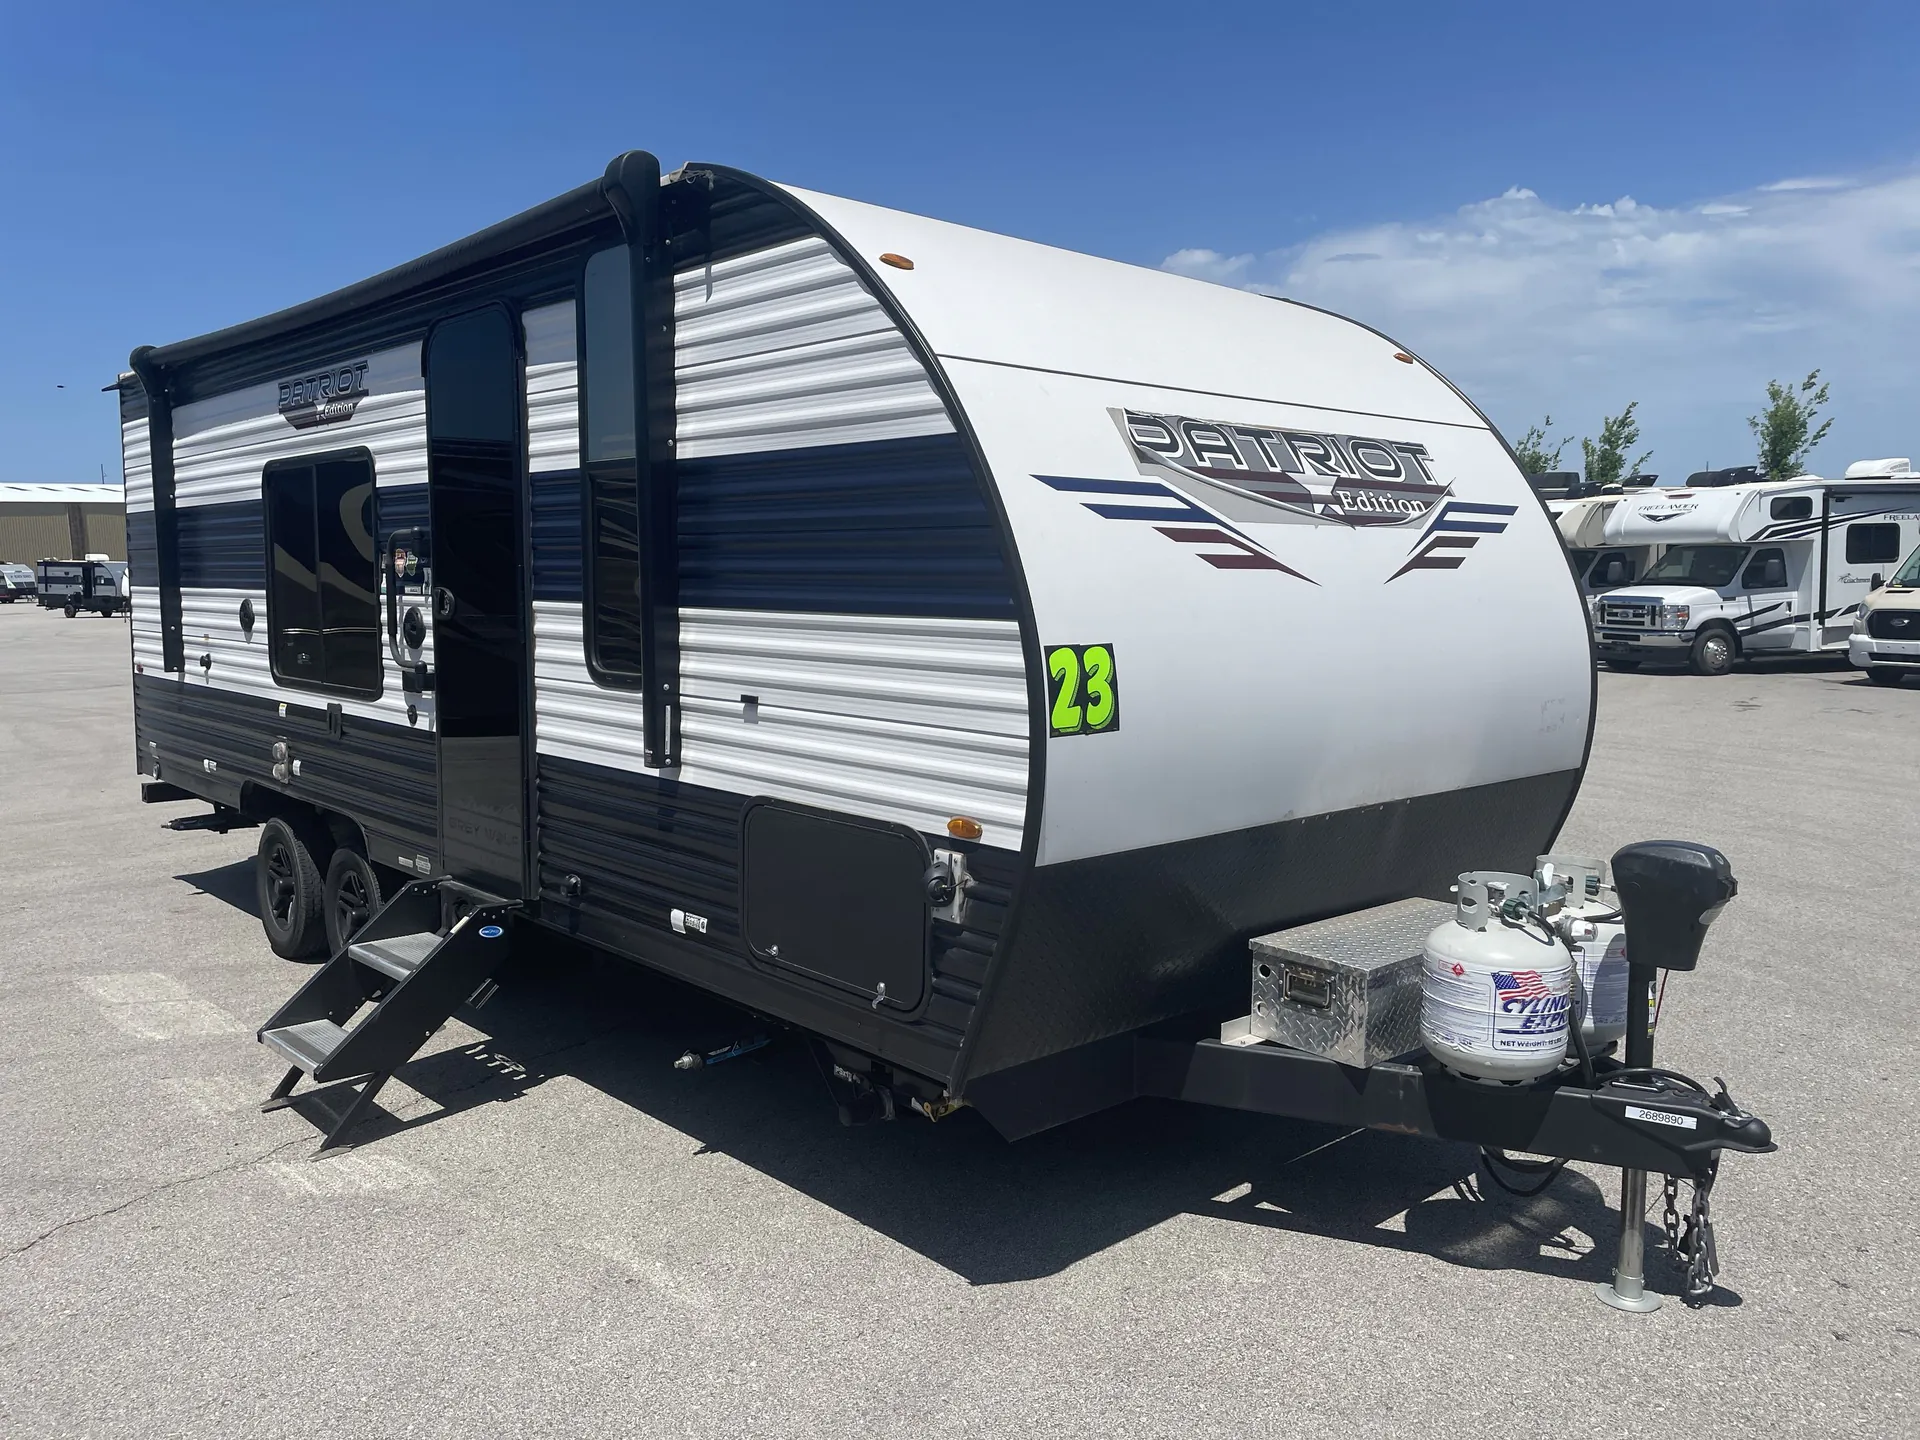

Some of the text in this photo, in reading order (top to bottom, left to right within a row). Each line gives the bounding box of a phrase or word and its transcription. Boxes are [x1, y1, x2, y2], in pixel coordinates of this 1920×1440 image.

[278, 360, 369, 409] PATRIOT
[324, 401, 354, 417] Edition
[1126, 415, 1435, 486] PATRIOT
[1336, 490, 1426, 514] Edition
[1048, 646, 1115, 733] 23
[1500, 1039, 1516, 1047] NET
[1638, 1109, 1684, 1126] 2689890
